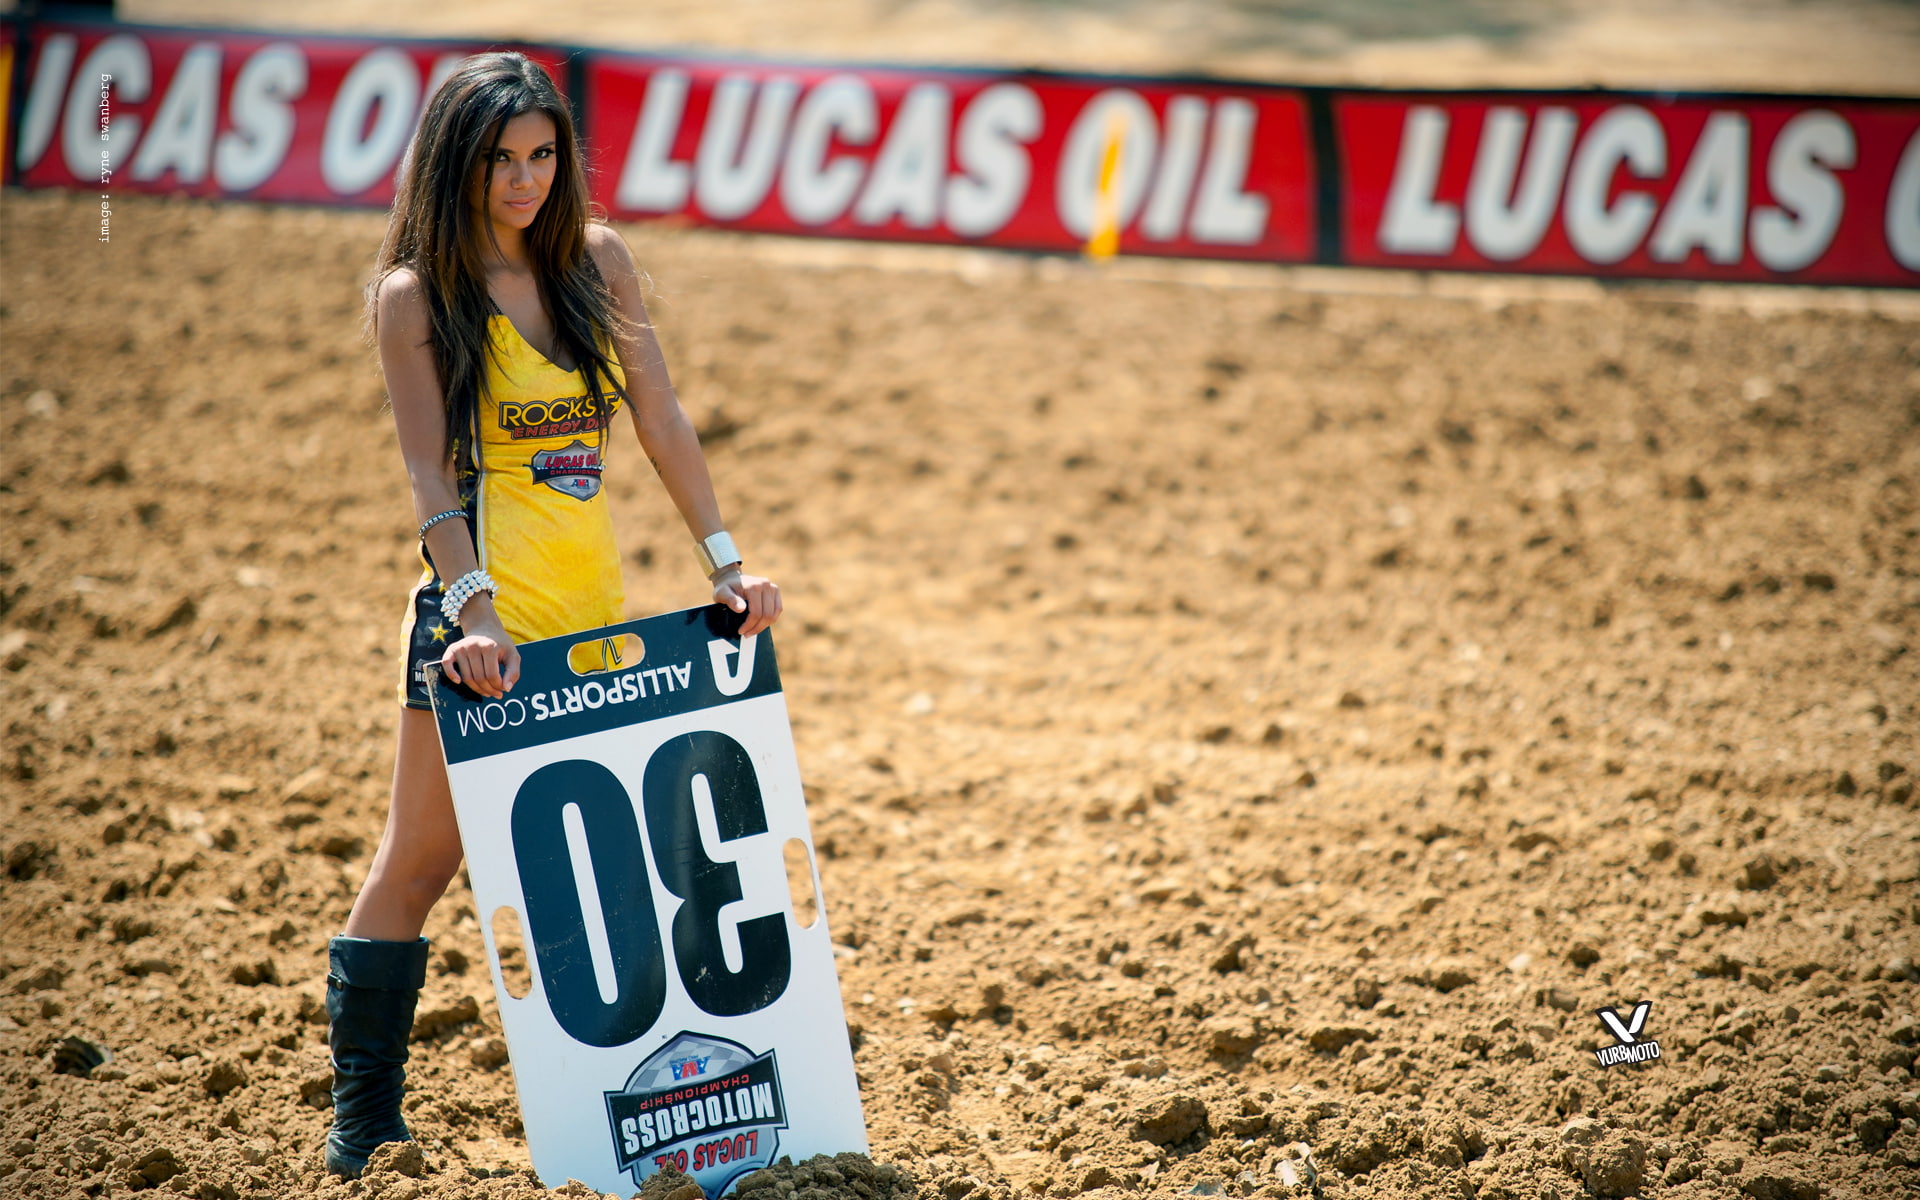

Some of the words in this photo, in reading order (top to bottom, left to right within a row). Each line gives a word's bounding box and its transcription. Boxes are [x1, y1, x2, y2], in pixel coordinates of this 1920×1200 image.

[614, 66, 1044, 237] LUCAS
[1055, 88, 1271, 246] OIL
[1378, 104, 1858, 272] LUCAS
[514, 419, 581, 438] ENERGY
[545, 455, 584, 468] LUCAS
[457, 661, 692, 737] ALLISPORTS.COM
[510, 729, 792, 1048] 30
[620, 1081, 776, 1156] MOTOCROSS
[640, 1074, 750, 1110] CHAMPIONSHIP
[693, 1130, 758, 1172] LUCAS
